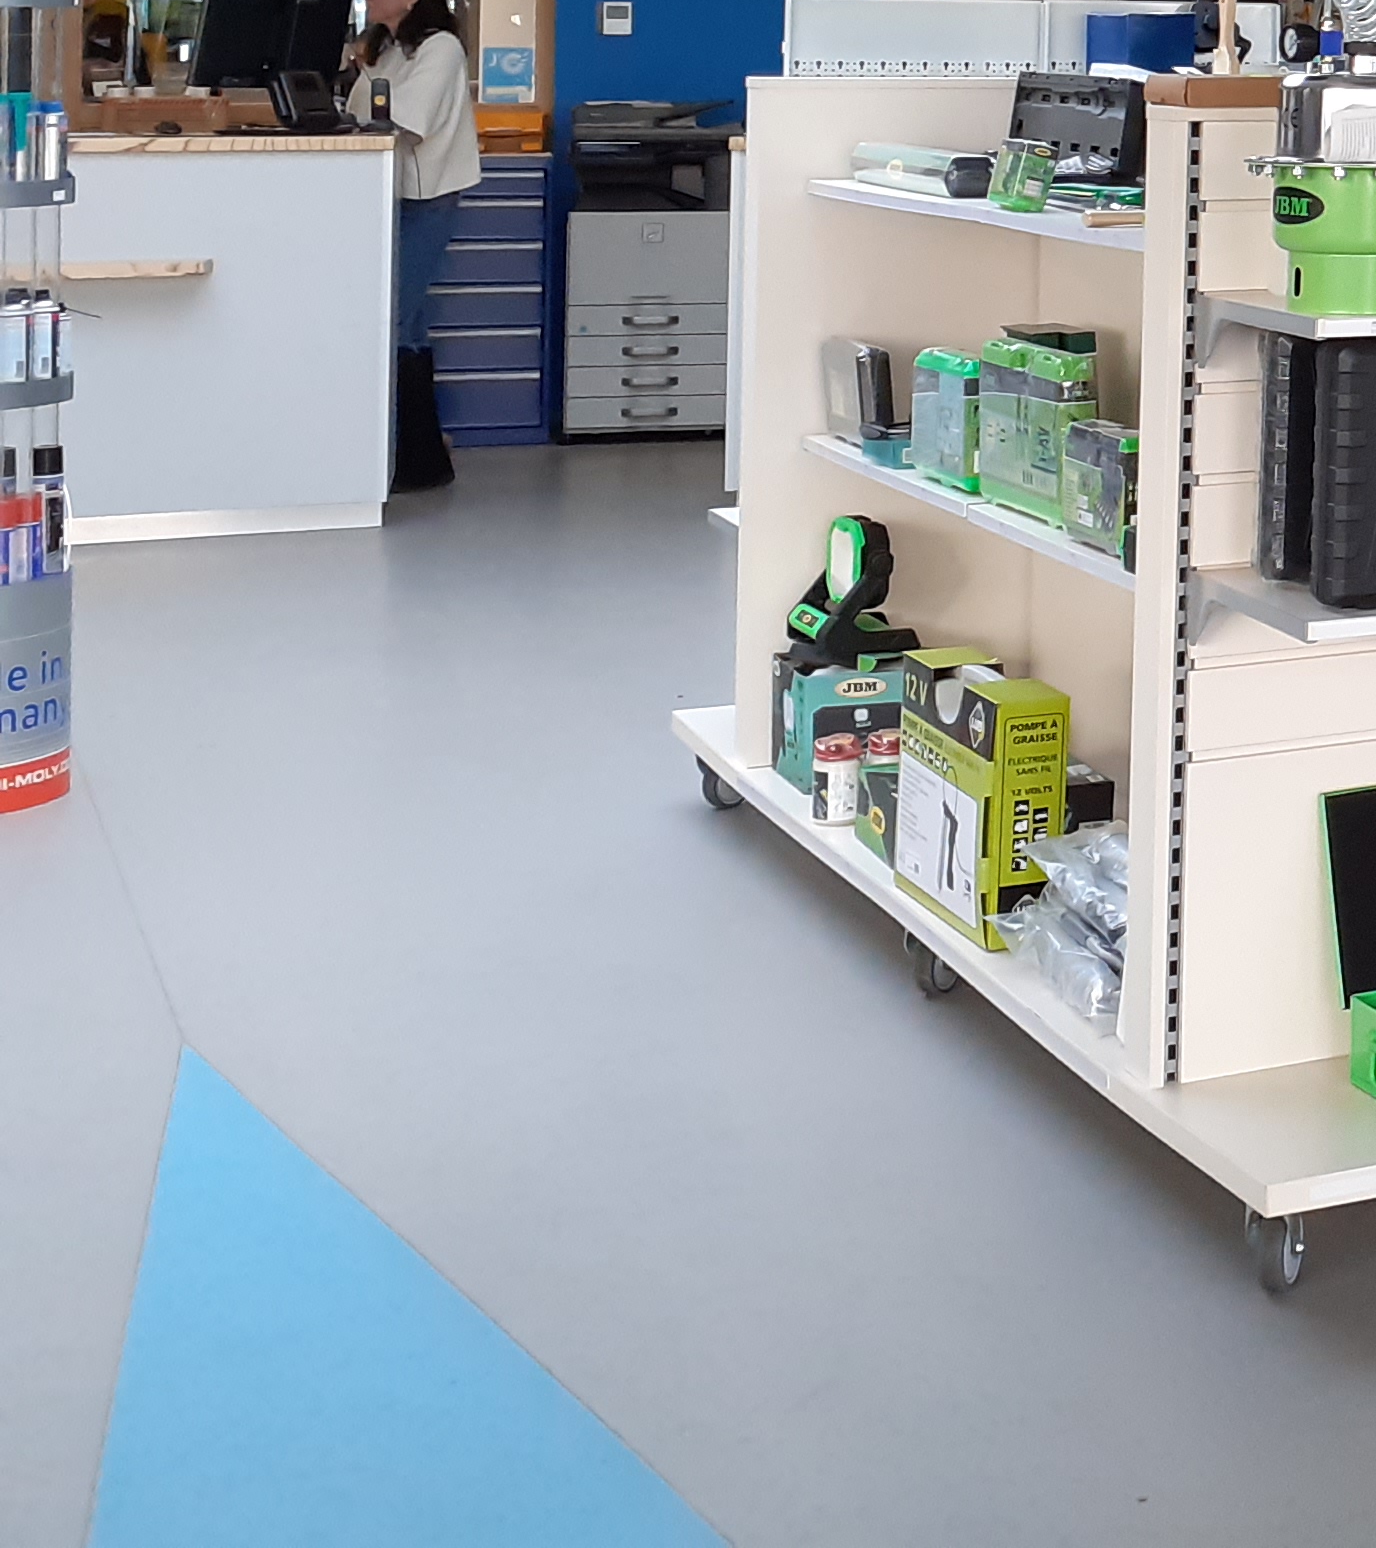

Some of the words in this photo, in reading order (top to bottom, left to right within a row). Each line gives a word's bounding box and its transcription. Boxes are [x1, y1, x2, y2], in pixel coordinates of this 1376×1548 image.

[1275, 195, 1312, 217] JBM
[842, 681, 878, 694] JBM
[905, 672, 917, 702] 12
[920, 680, 928, 706] V
[1010, 721, 1048, 732] POMPE
[1013, 733, 1057, 744] GRAISSE
